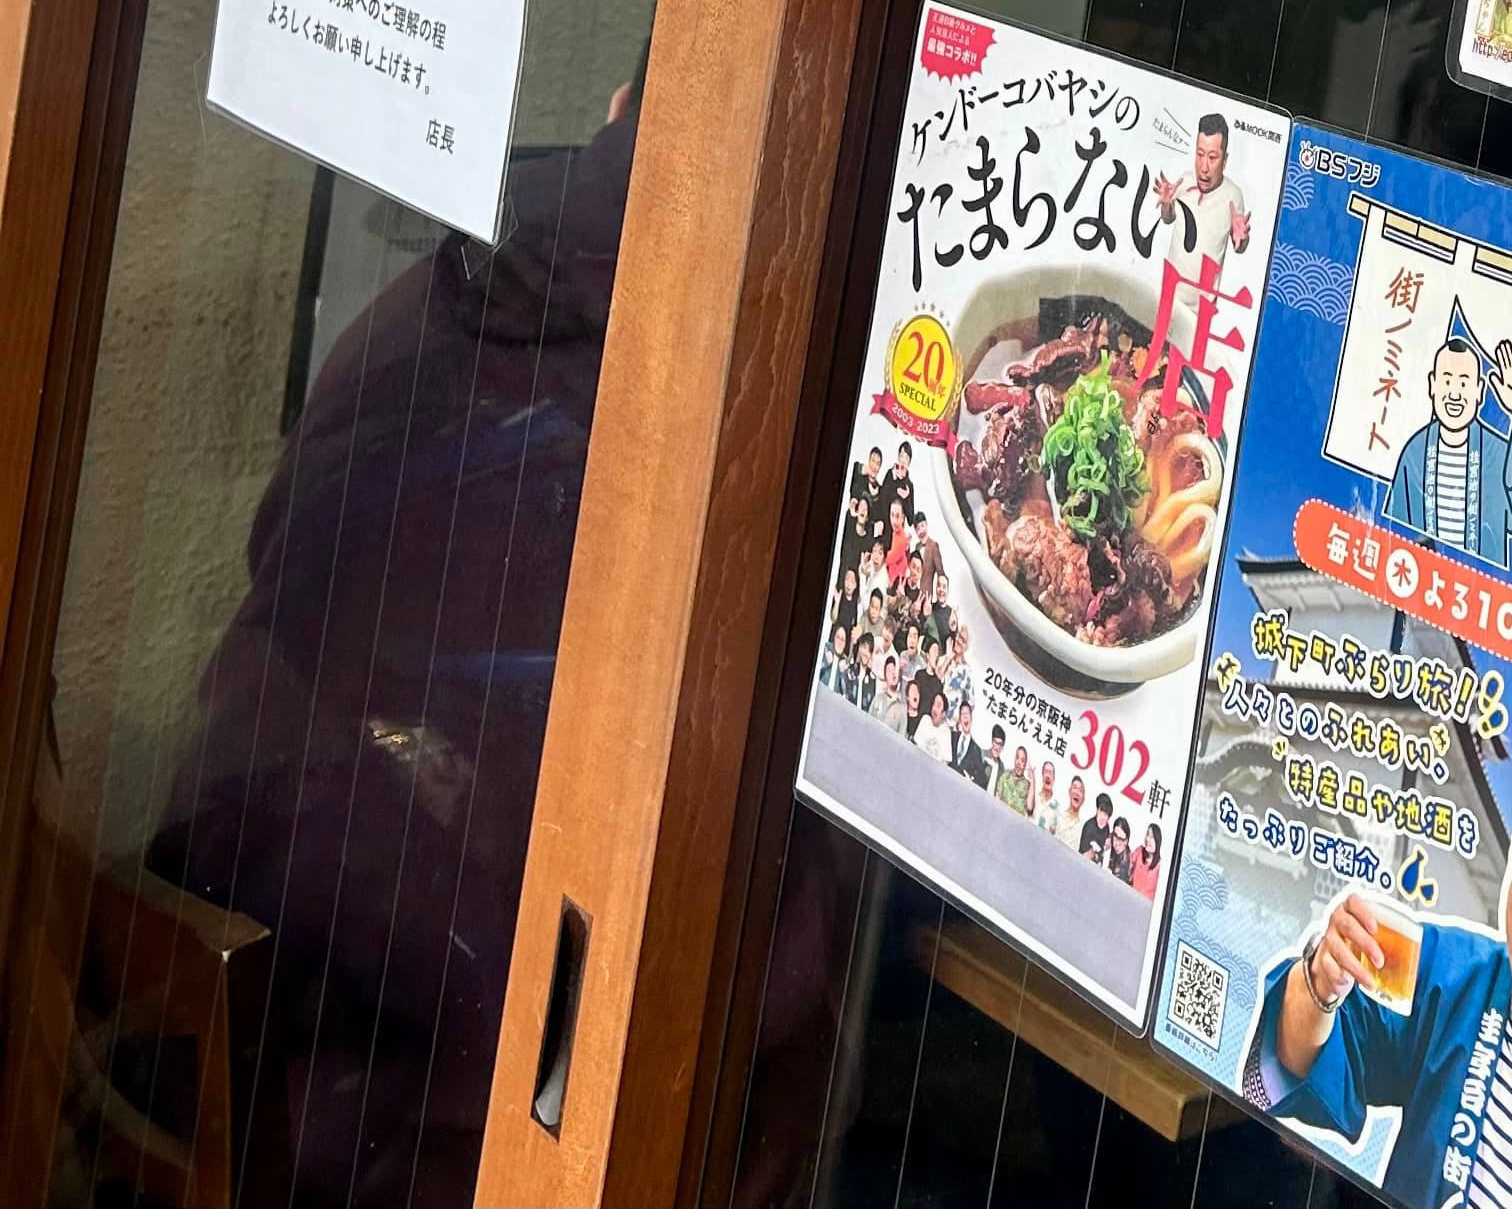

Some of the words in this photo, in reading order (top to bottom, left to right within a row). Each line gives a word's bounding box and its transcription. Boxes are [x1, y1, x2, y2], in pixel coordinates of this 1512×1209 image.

[425, 119, 454, 155] 店長
[911, 69, 1141, 166] ケンドーコバヤシの
[897, 126, 1198, 292] たまらない
[1316, 148, 1380, 187] BSフジ
[903, 331, 944, 389] 20
[1134, 255, 1254, 440] 店
[1367, 266, 1424, 452] 街ノミネート
[899, 382, 936, 412] SPECIAL
[984, 667, 1072, 734] 20年分の京阪神
[1225, 690, 1446, 780] 人々とのふれあい。
[1070, 709, 1150, 806] 302
[1147, 779, 1171, 820] 軒
[1218, 796, 1393, 889] たっぷりご紹介。
[1288, 759, 1478, 854] 特産品や地酒を
